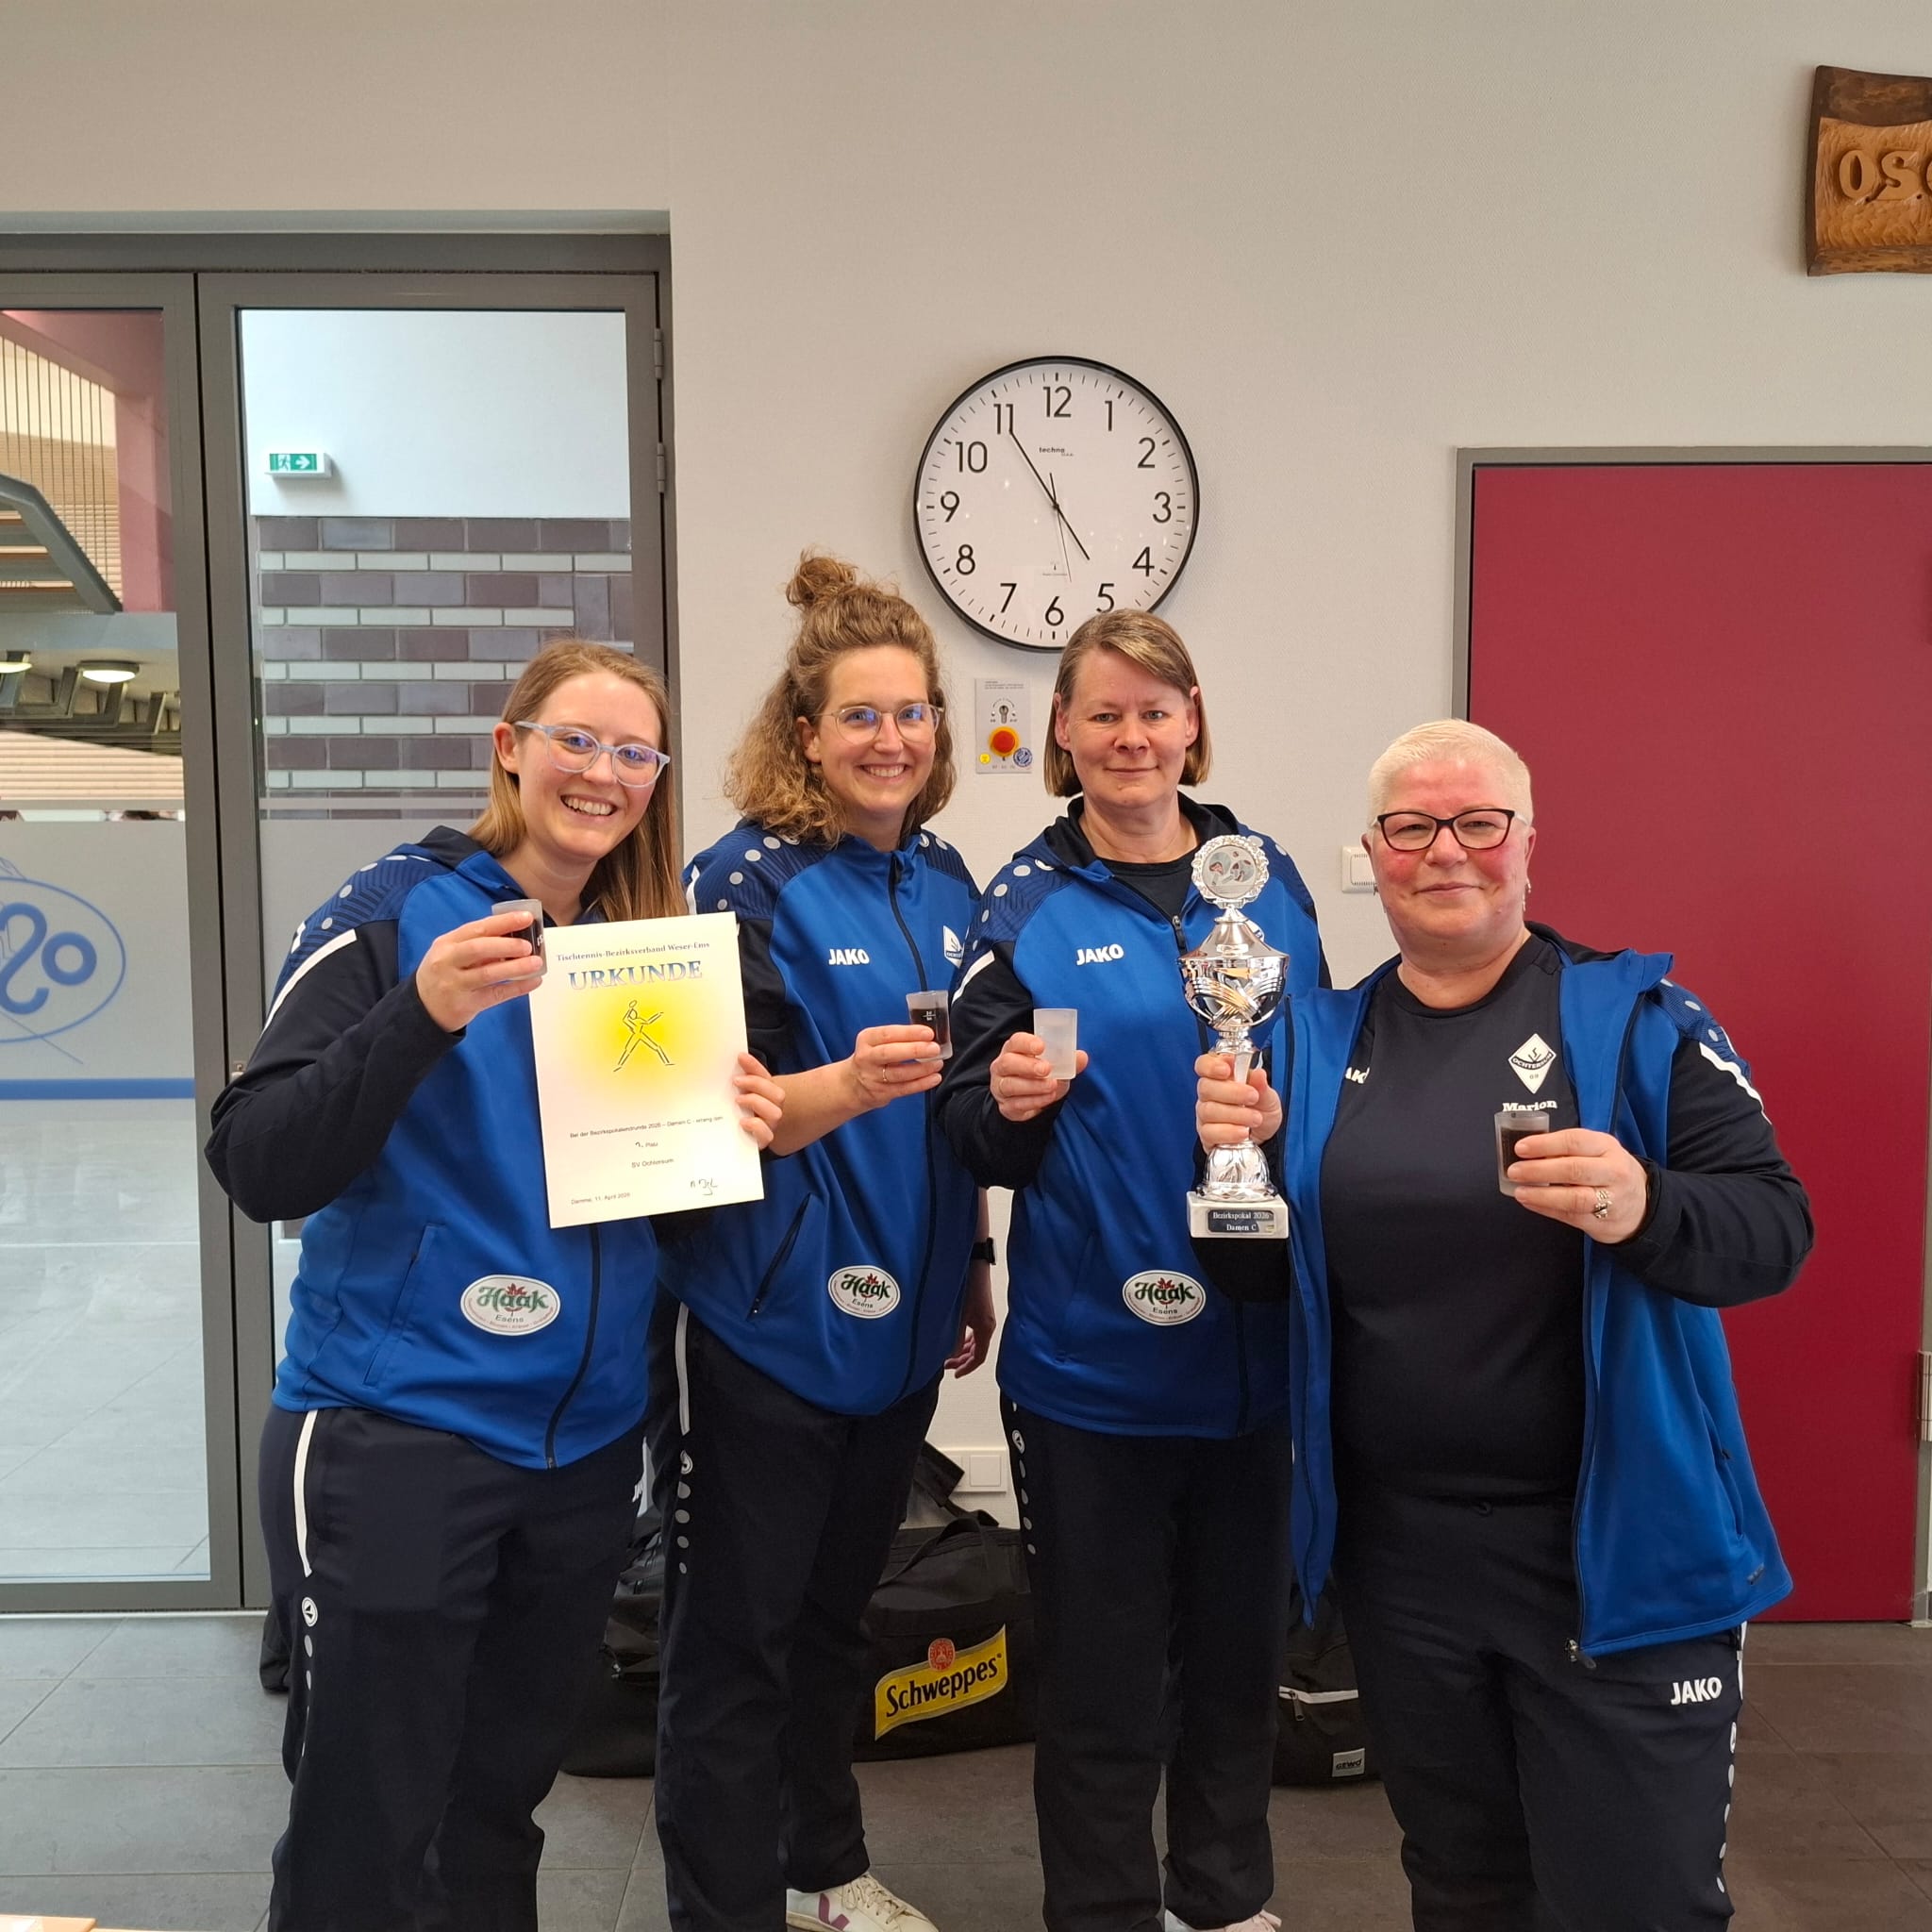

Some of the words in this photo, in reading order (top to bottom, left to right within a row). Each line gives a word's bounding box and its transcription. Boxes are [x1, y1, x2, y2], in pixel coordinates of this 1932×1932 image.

[1042, 386, 1072, 417] 12
[1105, 400, 1113, 431] 1
[993, 403, 1013, 435] 11
[955, 441, 988, 473] 10
[1137, 437, 1156, 469] 2
[941, 491, 960, 523] 9
[1152, 491, 1172, 523] 3
[956, 543, 976, 575] 8
[1132, 546, 1155, 576] 4
[1000, 582, 1017, 613] 7
[1044, 596, 1064, 626] 6
[1096, 583, 1115, 613] 5
[828, 948, 870, 965] JAKO
[1076, 943, 1124, 966] JAKO
[568, 960, 703, 991] URKUNDE
[1502, 1100, 1558, 1112] Marion
[1212, 1211, 1252, 1221] Bezirkspokal
[476, 1286, 549, 1313] Haak
[840, 1273, 891, 1302] Haak
[1134, 1282, 1195, 1306] Haak
[886, 1657, 998, 1718] Schweppes
[1670, 1676, 1723, 1706] JAKO
